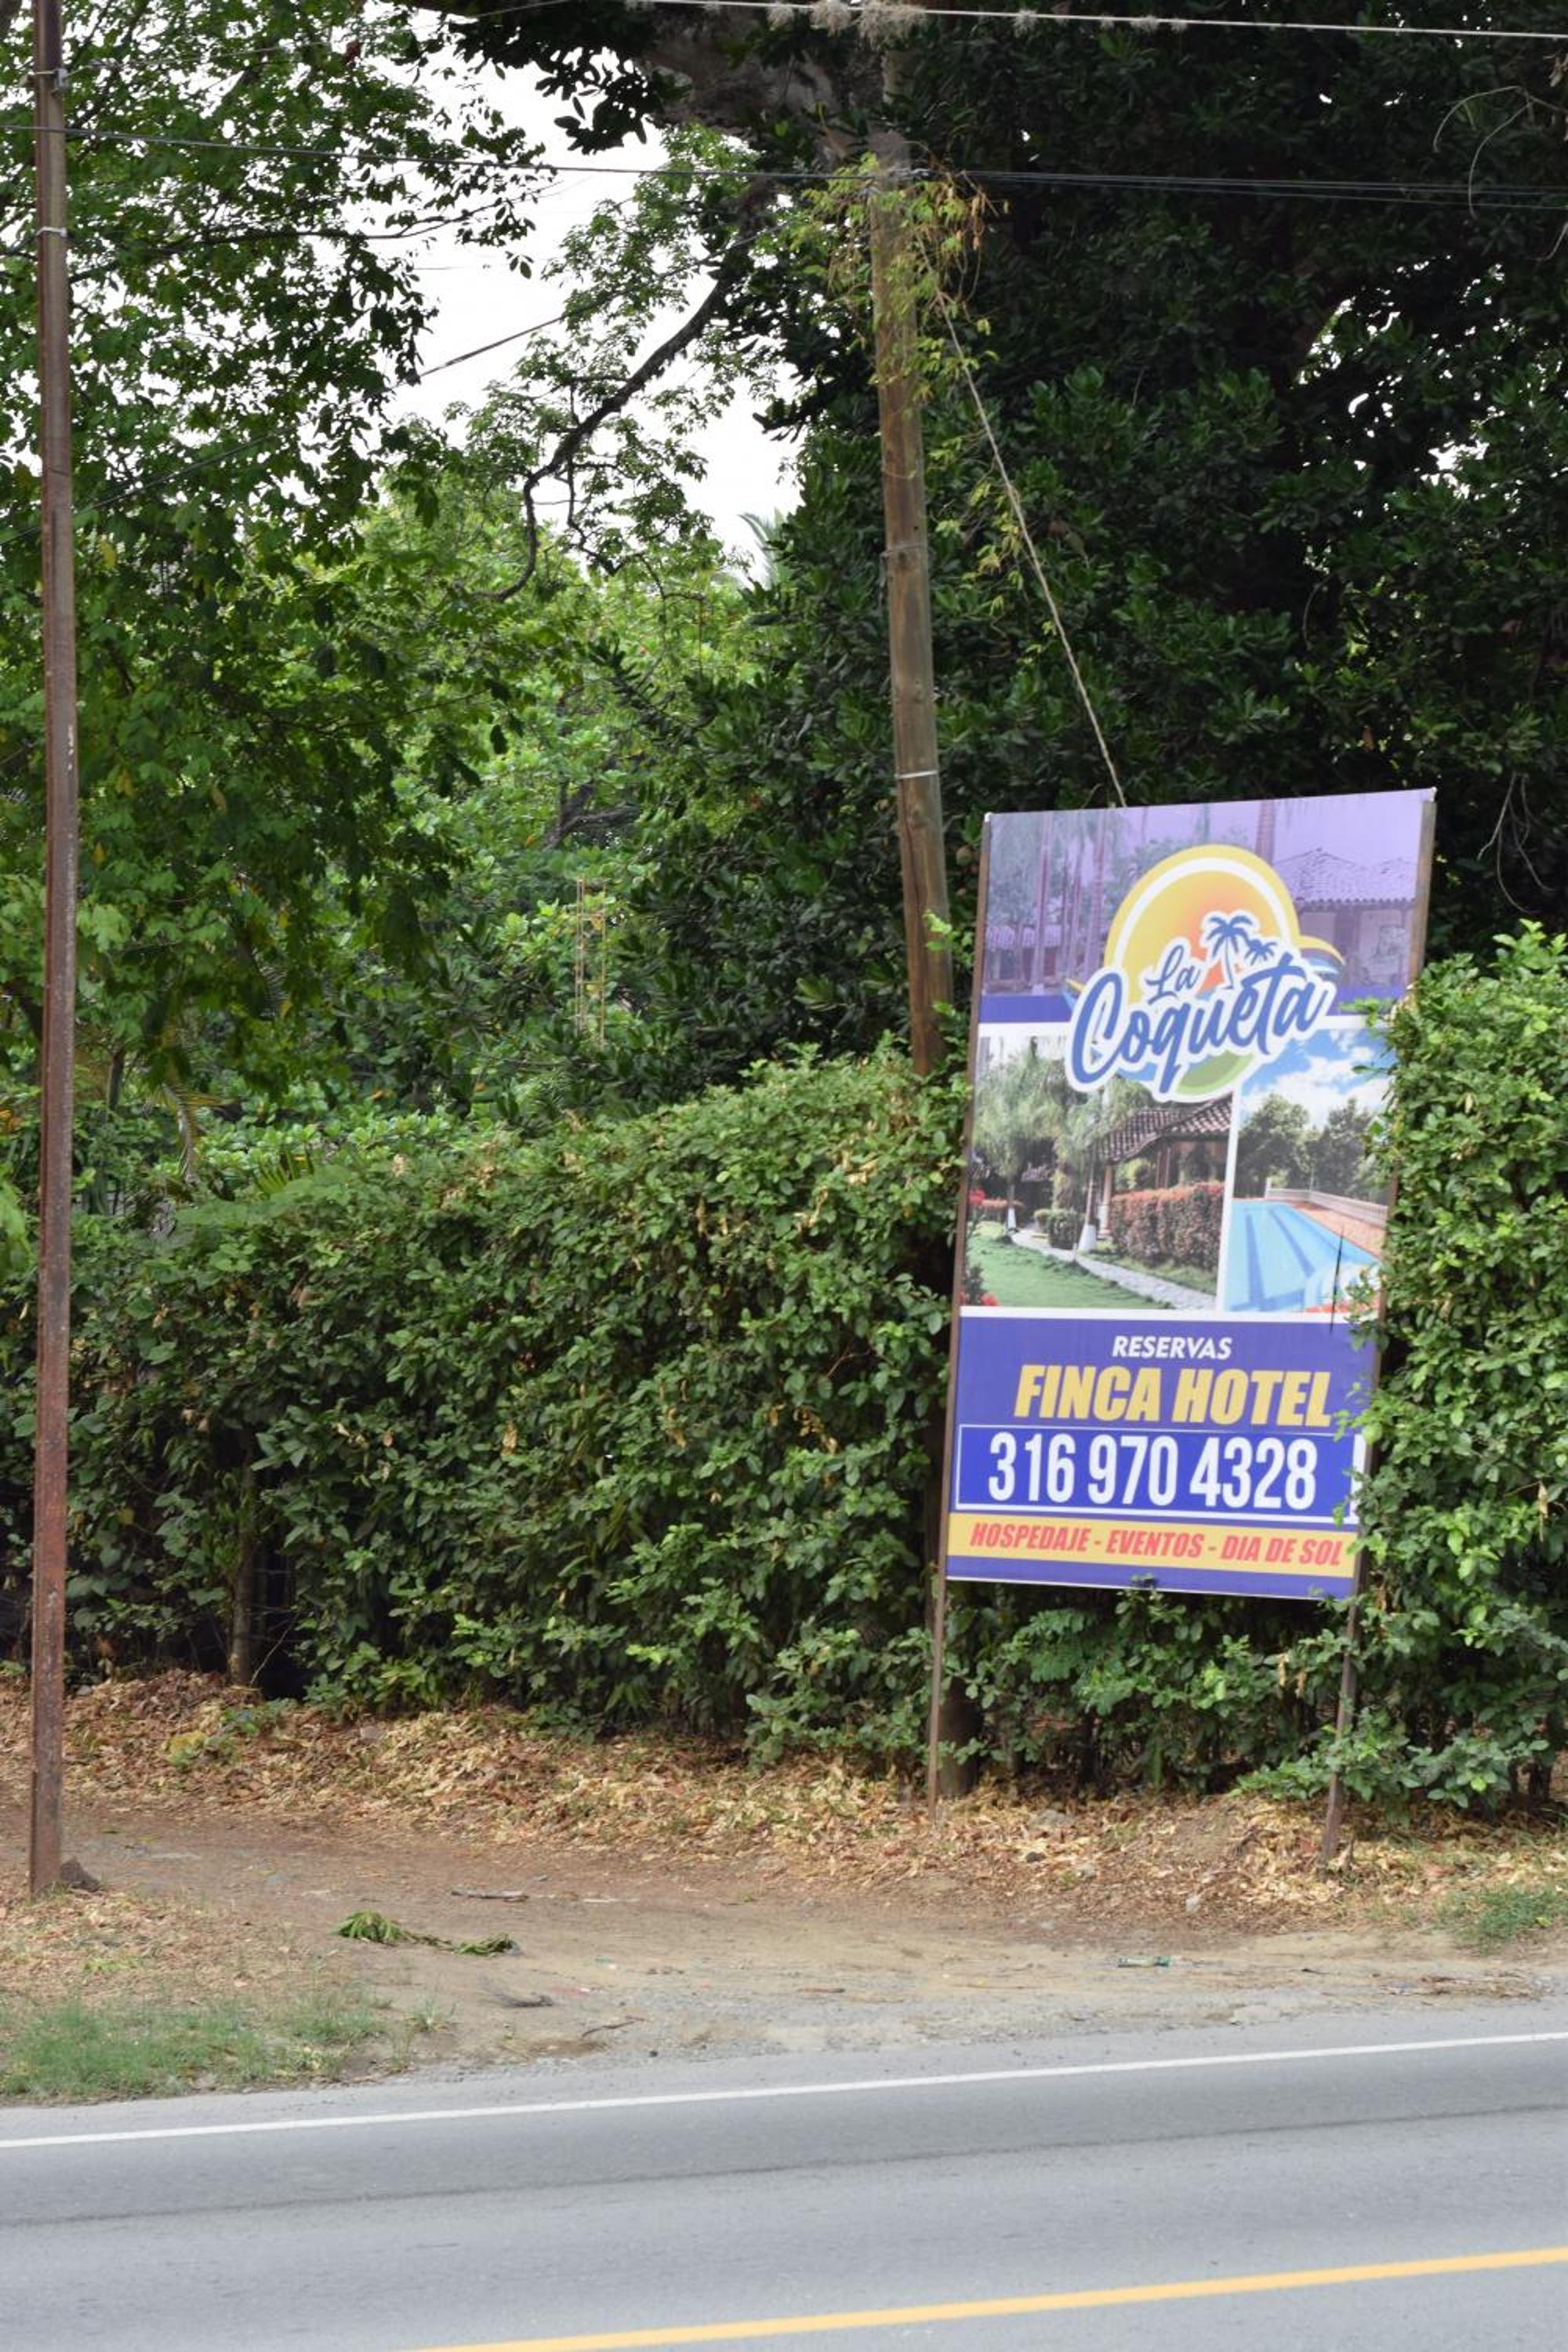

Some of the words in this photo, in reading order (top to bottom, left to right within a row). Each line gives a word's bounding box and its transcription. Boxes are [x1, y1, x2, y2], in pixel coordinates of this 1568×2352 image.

[1145, 945, 1201, 1004] La
[1072, 953, 1330, 1094] Coqueta
[1112, 1336, 1232, 1360] RESERVAS
[1014, 1364, 1161, 1423] FINCA
[1172, 1368, 1331, 1428] HOTEL
[988, 1432, 1076, 1504] 316
[1087, 1433, 1178, 1507] 970
[1189, 1436, 1317, 1510] 4328
[970, 1523, 1091, 1552] HOSPEDAJE
[1105, 1530, 1204, 1558] EVENTOS
[1221, 1535, 1262, 1562] DIA
[1265, 1537, 1295, 1563] DE
[1300, 1540, 1344, 1566] SOL
